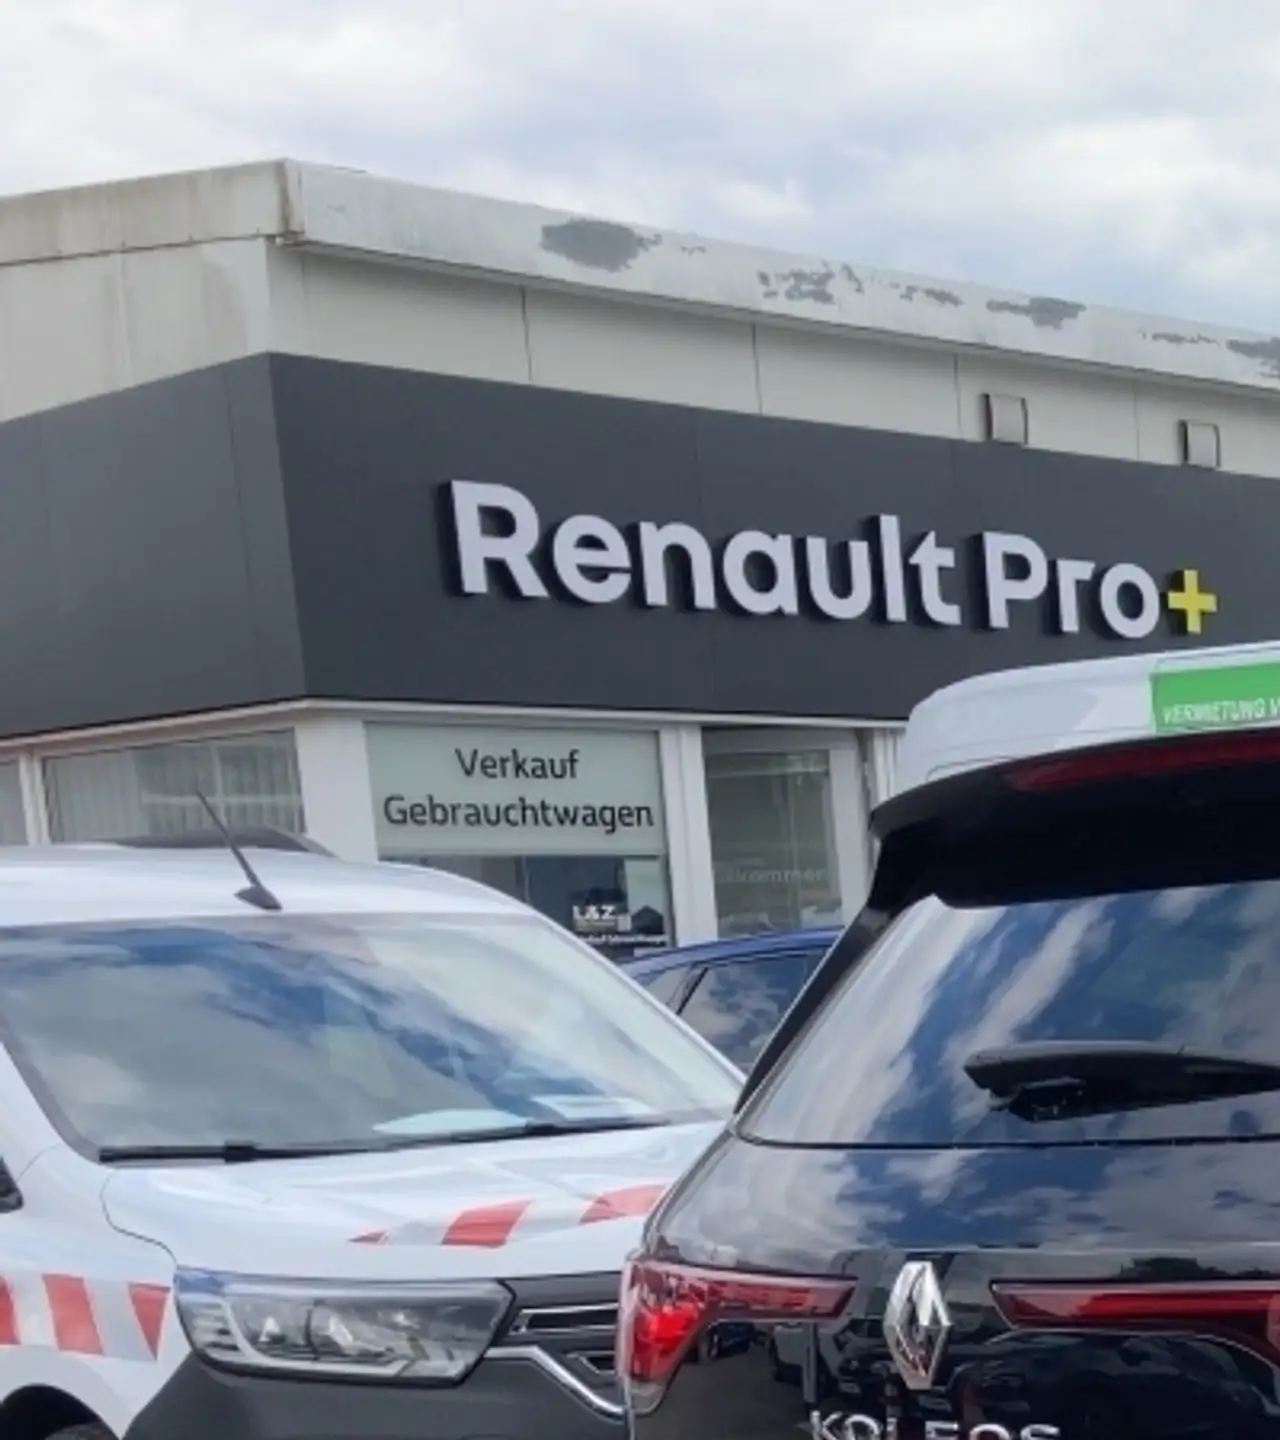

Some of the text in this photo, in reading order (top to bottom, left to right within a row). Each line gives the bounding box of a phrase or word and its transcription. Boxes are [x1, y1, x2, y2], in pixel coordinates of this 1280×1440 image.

[450, 479, 1218, 640] Renault Pro+
[454, 748, 580, 779] Verkauf
[383, 794, 654, 834] Gebrauchtwagen
